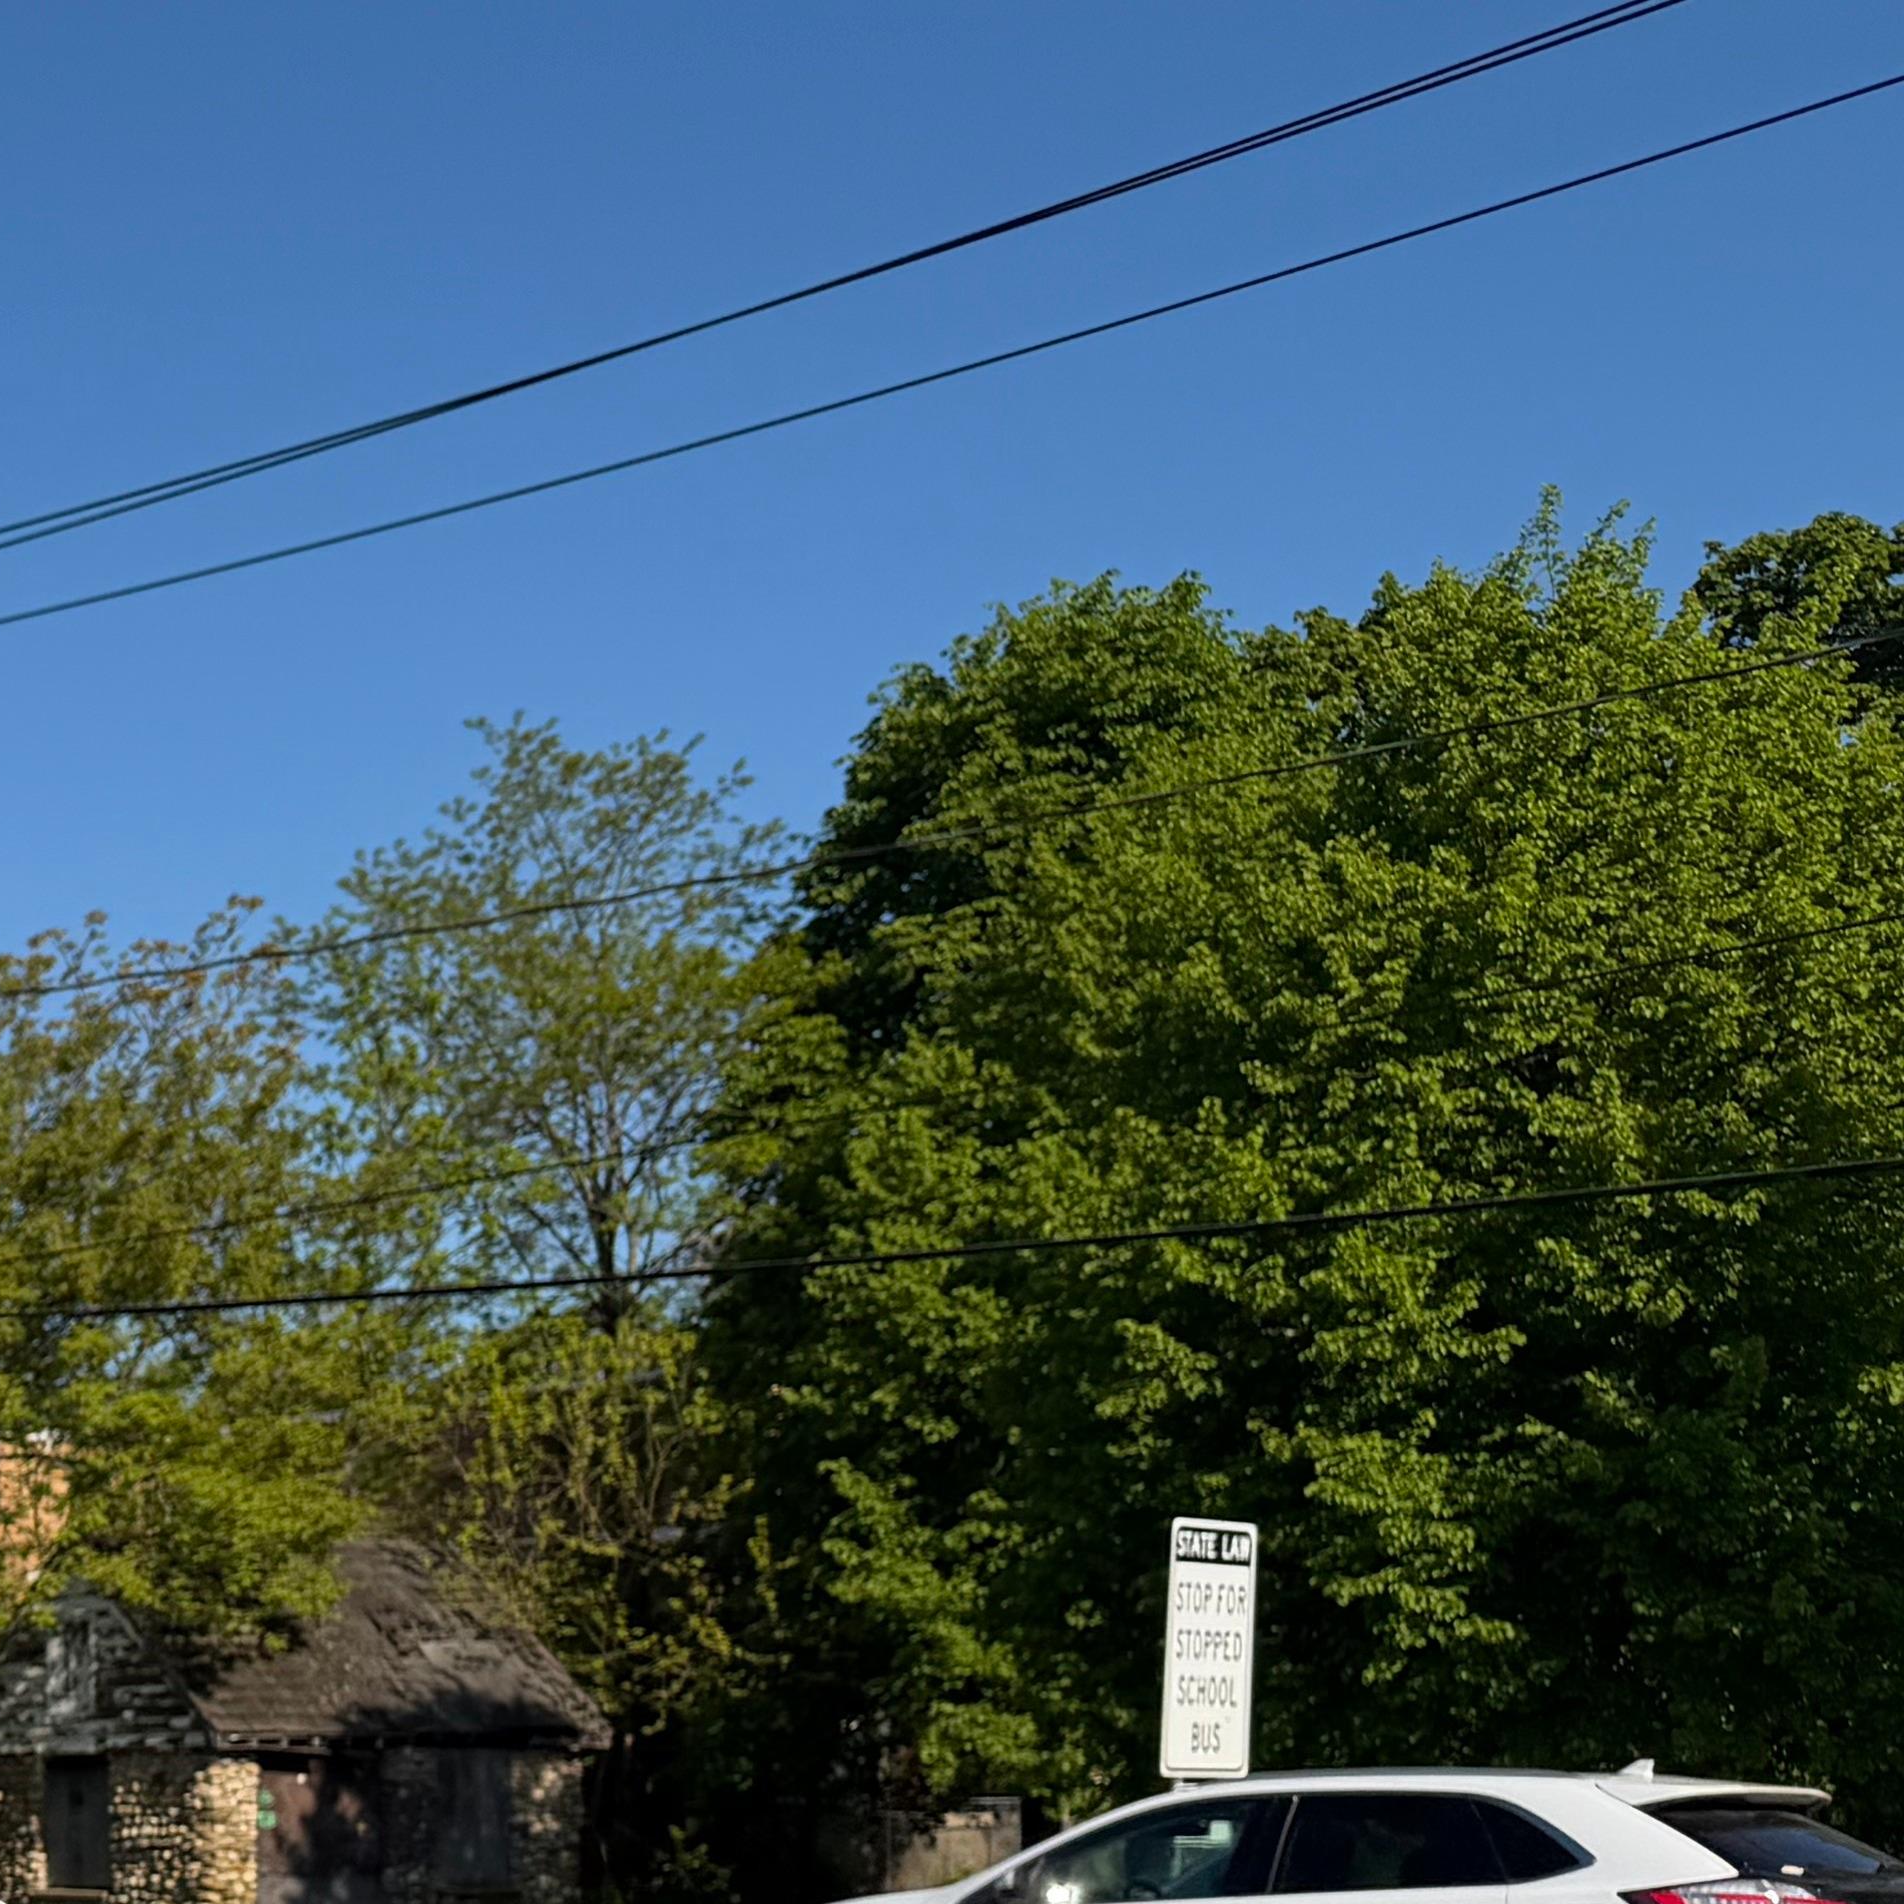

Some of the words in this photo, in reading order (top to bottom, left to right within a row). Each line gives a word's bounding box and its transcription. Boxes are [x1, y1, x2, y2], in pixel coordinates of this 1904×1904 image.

[1176, 1530, 1217, 1559] STATE
[1221, 1534, 1250, 1562] LAW
[1176, 1582, 1212, 1613] STOP
[1217, 1584, 1247, 1615] FOR
[1176, 1629, 1242, 1661] STOPPED
[1176, 1675, 1237, 1708] SCHOOL
[1191, 1722, 1220, 1754] BUS
